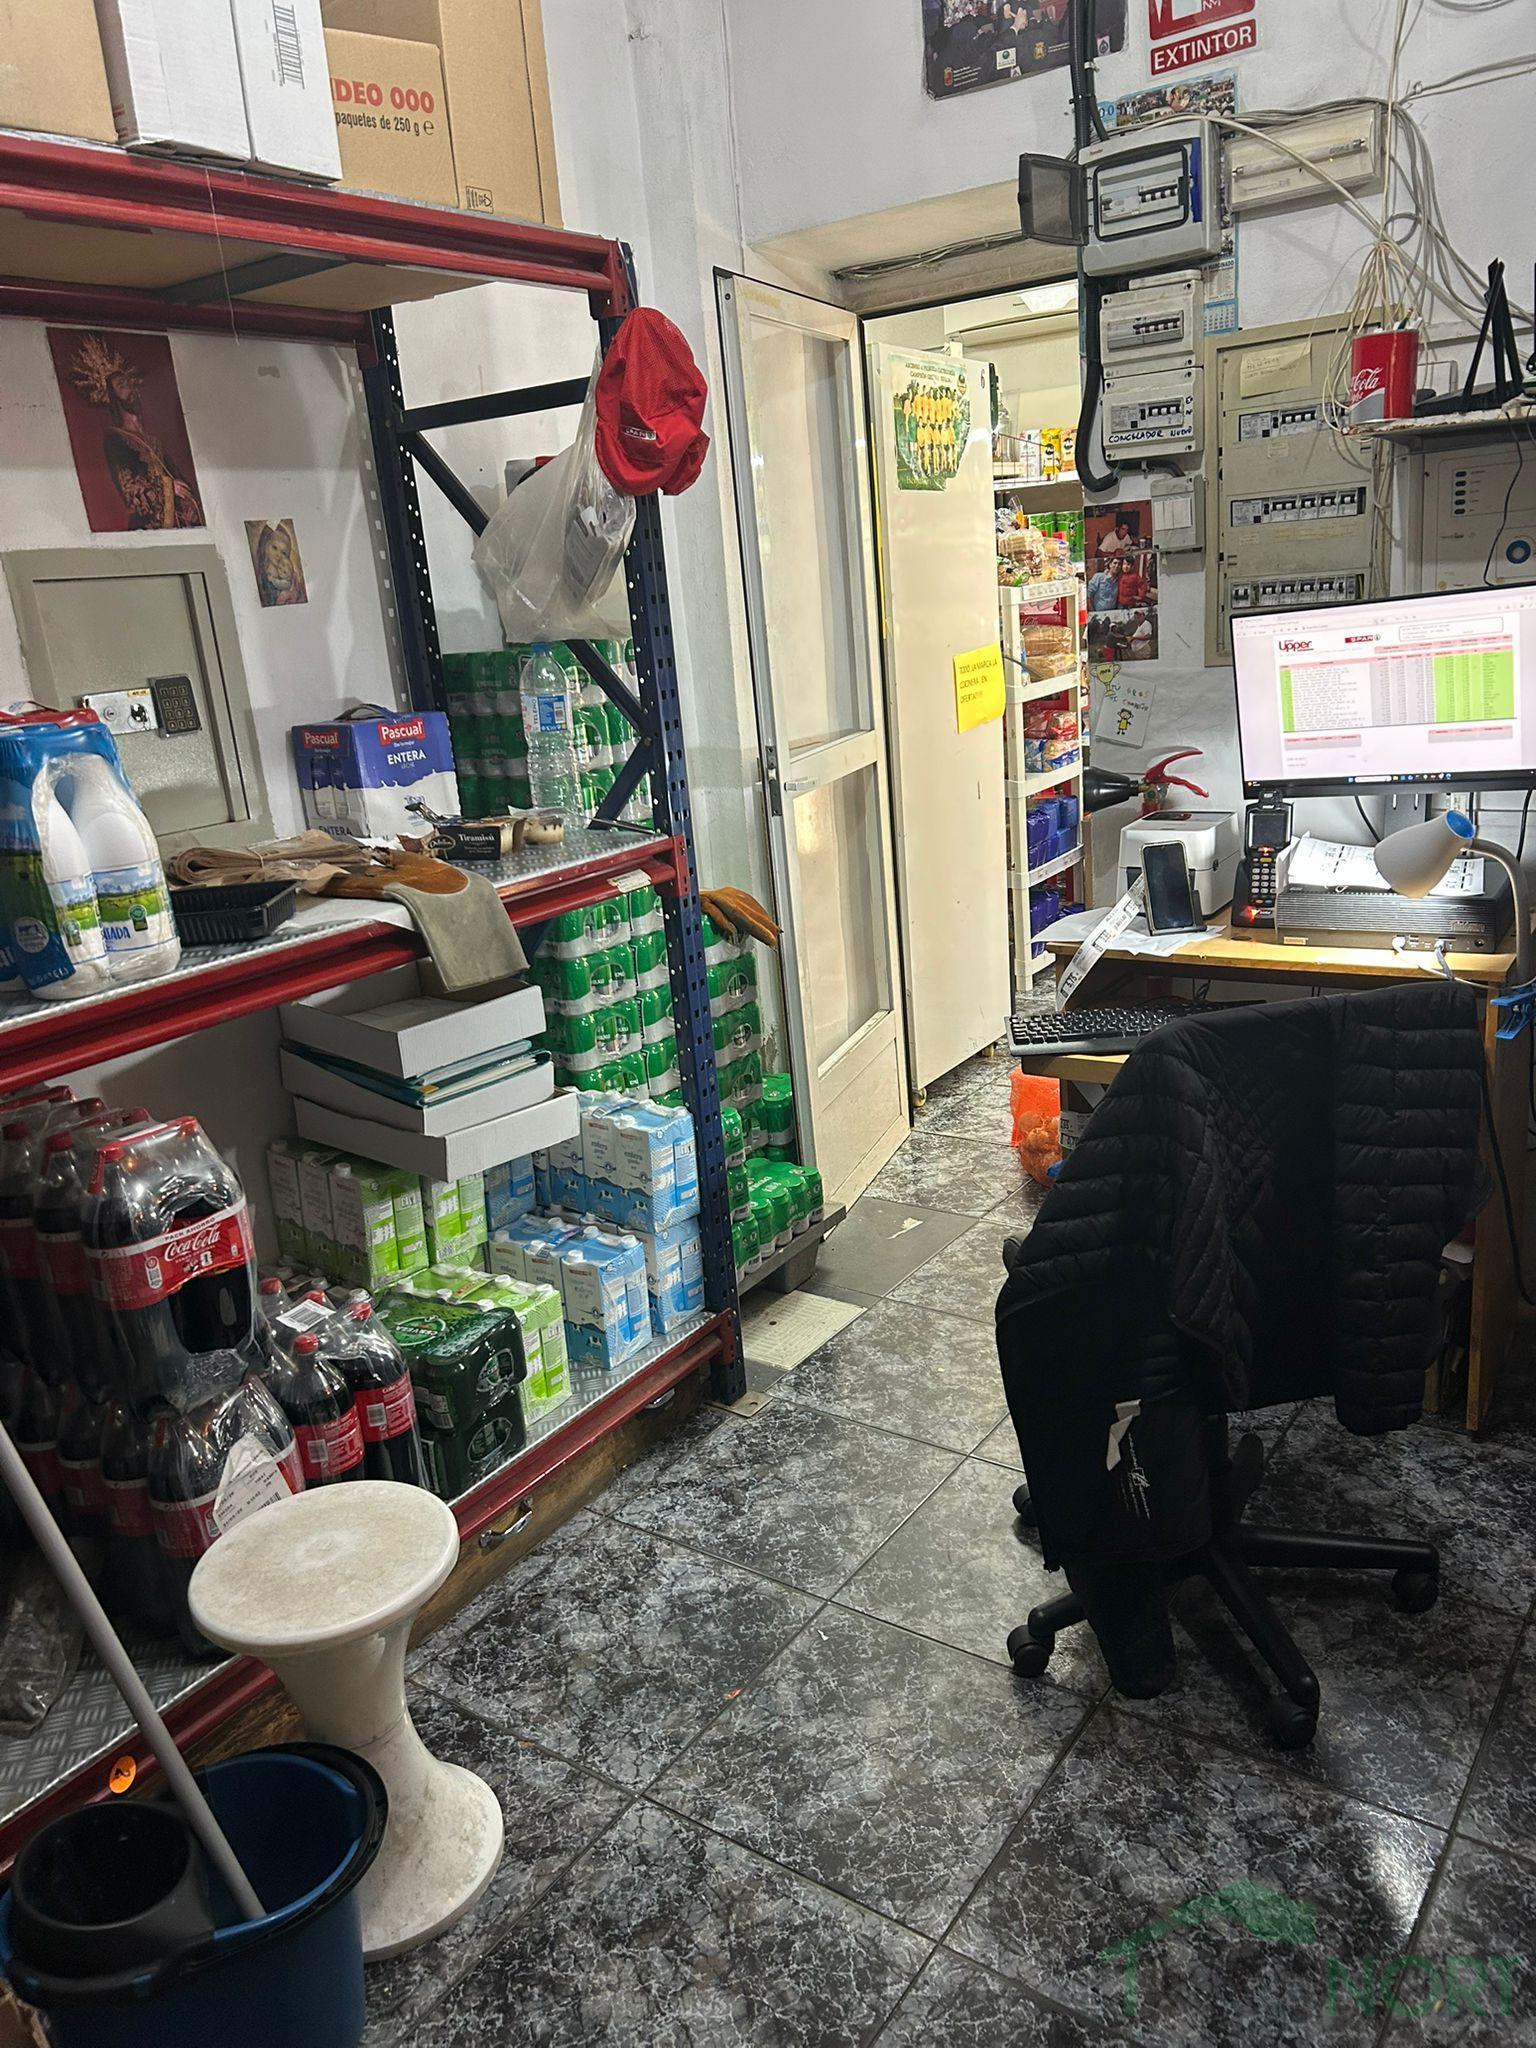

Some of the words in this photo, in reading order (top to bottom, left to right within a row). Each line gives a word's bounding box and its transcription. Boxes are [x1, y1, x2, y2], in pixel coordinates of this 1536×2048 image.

[1154, 25, 1252, 71] EXTINTOR
[334, 111, 377, 129] paquetes
[380, 115, 391, 130] de
[395, 117, 411, 132] 250
[414, 122, 420, 137] g
[1108, 430, 1163, 443] CONGELADOR
[1278, 640, 1313, 652] Upper
[304, 732, 339, 744] Pascual
[381, 720, 424, 740] Pascual
[387, 749, 427, 765] ENTERA
[164, 1231, 185, 1241] PACK
[185, 1216, 216, 1237] AHORRO
